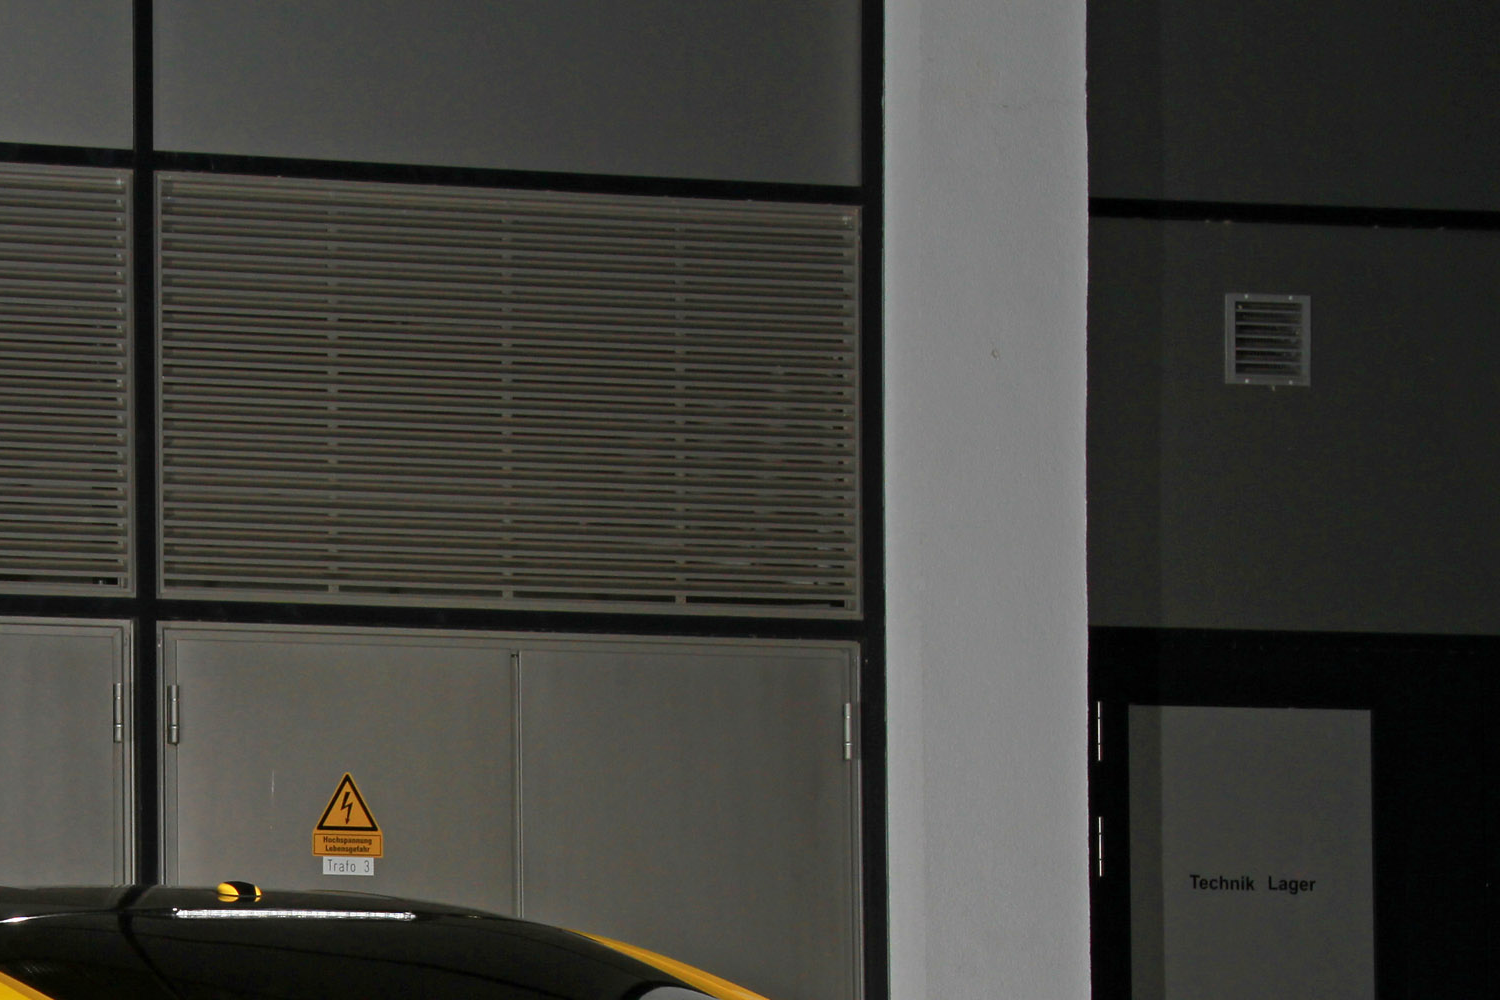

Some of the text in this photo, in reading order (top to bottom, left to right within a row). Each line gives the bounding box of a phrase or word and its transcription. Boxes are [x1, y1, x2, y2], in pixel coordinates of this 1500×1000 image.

[323, 836, 372, 845] Hochspannung
[325, 845, 370, 853] Lebensgefahr
[328, 859, 370, 873] Trafo 3
[1190, 874, 1316, 895] Technik Lager
